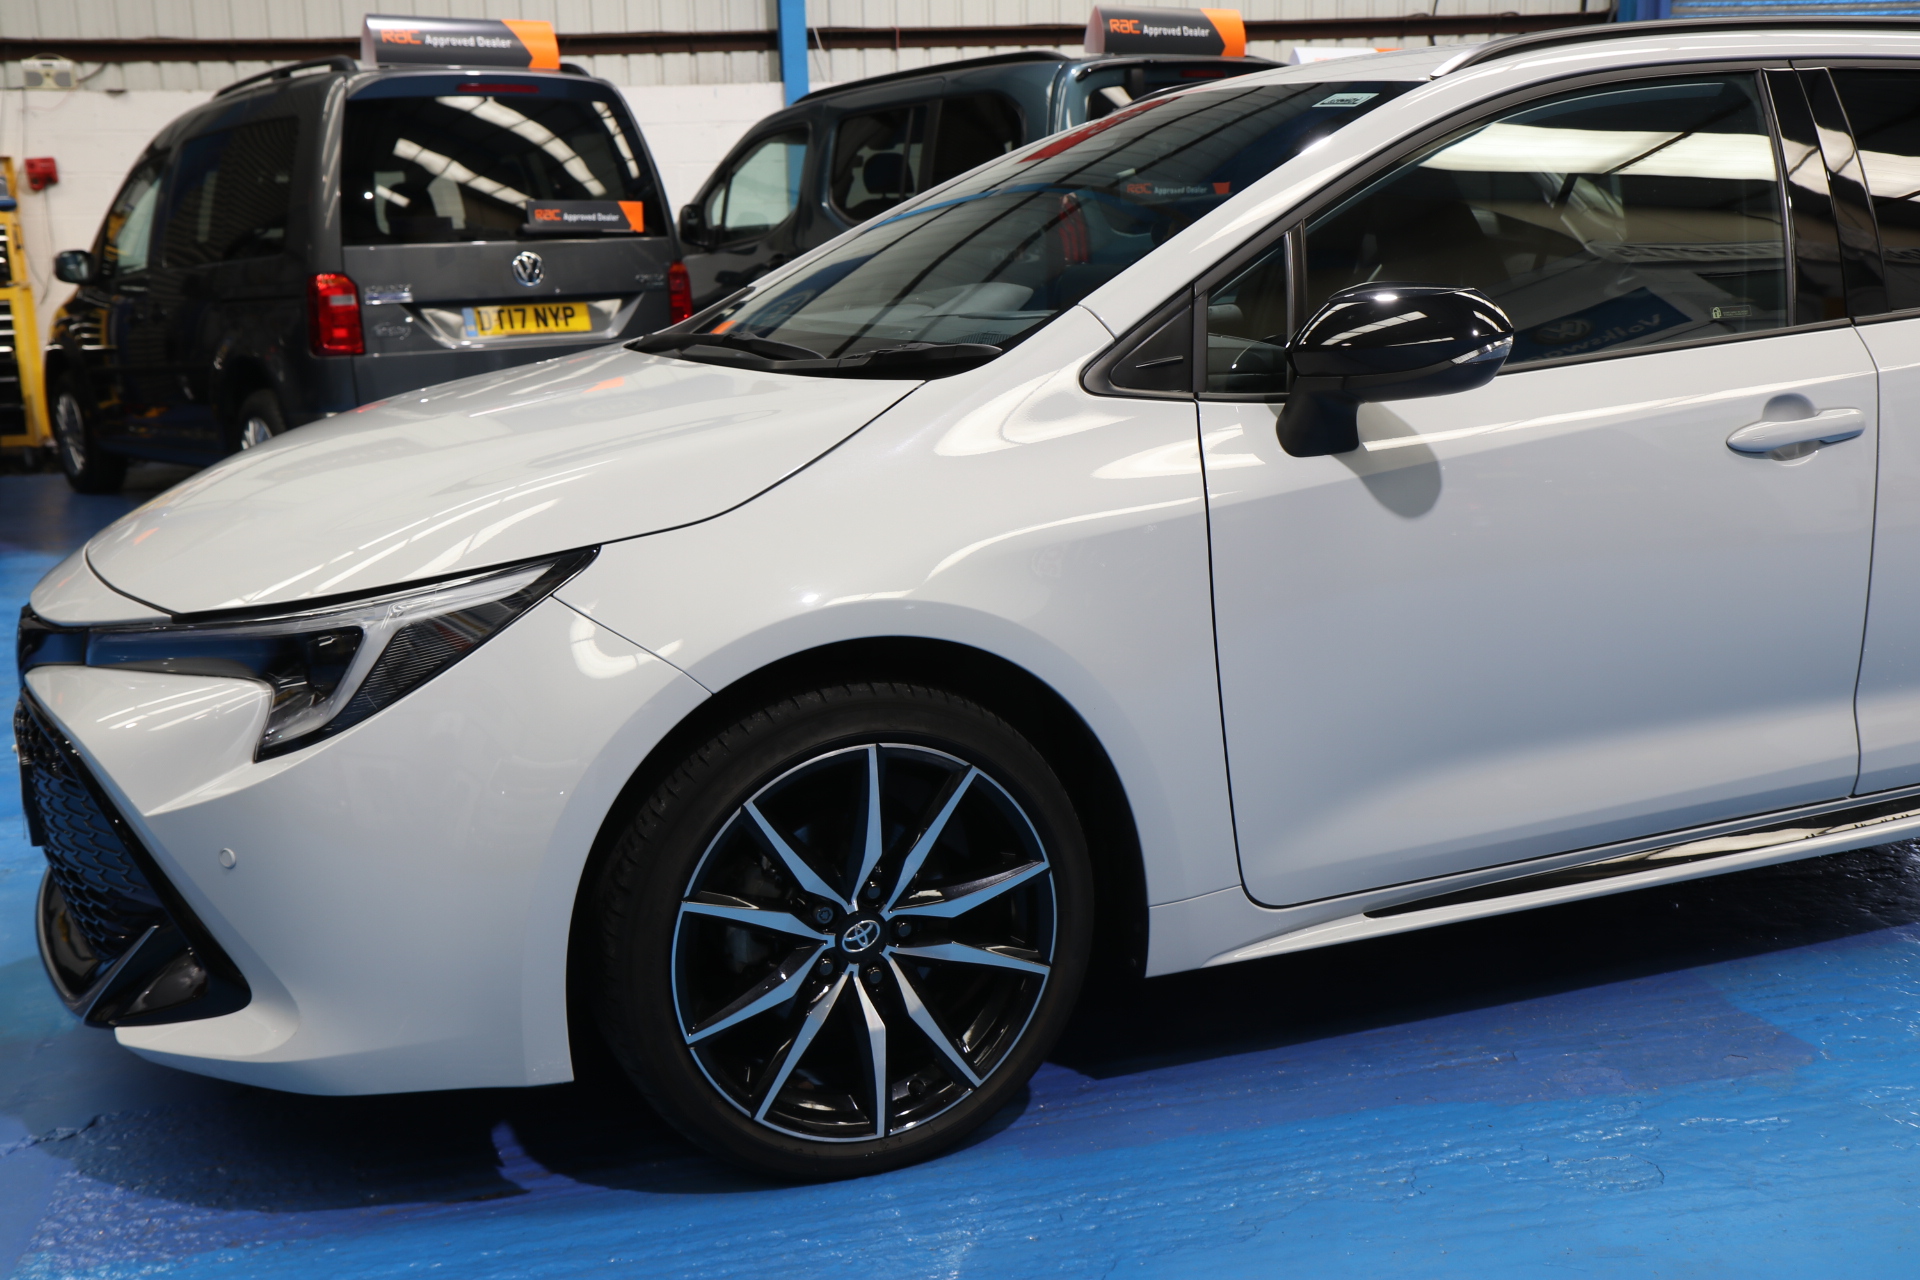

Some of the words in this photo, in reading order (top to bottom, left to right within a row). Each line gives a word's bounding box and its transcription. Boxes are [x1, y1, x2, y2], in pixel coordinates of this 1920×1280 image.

[1143, 25, 1181, 37] Approved
[1183, 25, 1210, 37] Dealer
[424, 34, 475, 48] Approved
[476, 36, 512, 49] Dealer
[1154, 186, 1185, 195] Approved
[1186, 185, 1208, 194] Dealer
[563, 212, 596, 222] Approved
[597, 212, 620, 222] Dealer
[478, 309, 527, 331] DT17
[533, 305, 576, 328] NYP
